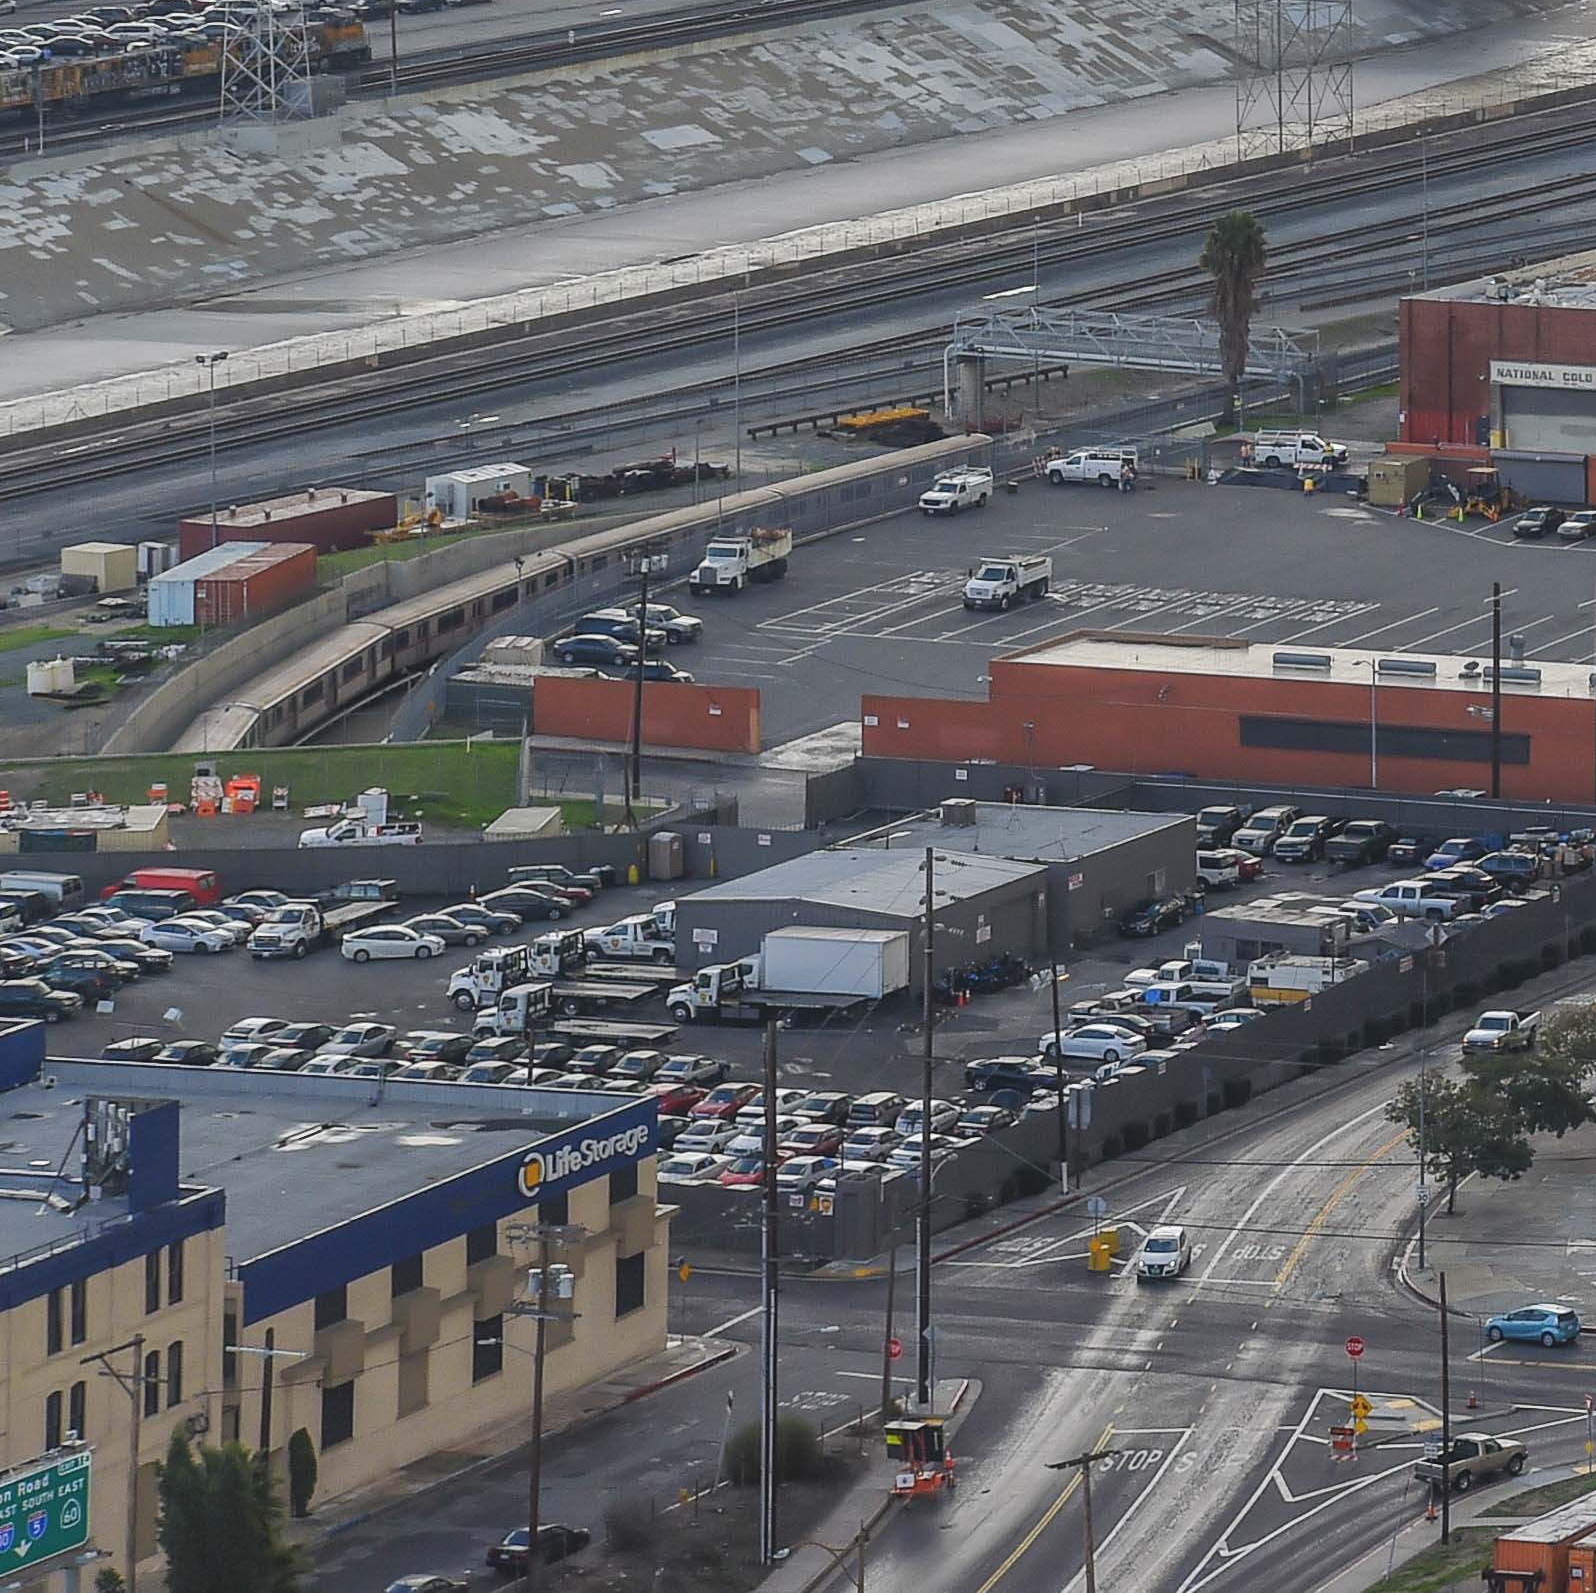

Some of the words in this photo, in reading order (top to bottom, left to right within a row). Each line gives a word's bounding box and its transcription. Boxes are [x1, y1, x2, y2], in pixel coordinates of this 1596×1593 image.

[1497, 367, 1555, 382] NATIONAL
[1562, 372, 1593, 383] COLD
[1099, 1450, 1165, 1473] STOP
[18, 1473, 50, 1497] Road
[22, 1490, 55, 1511] SOUTH
[58, 1477, 86, 1497] EAST
[63, 1508, 77, 1524] 60
[33, 1520, 41, 1535] 5
